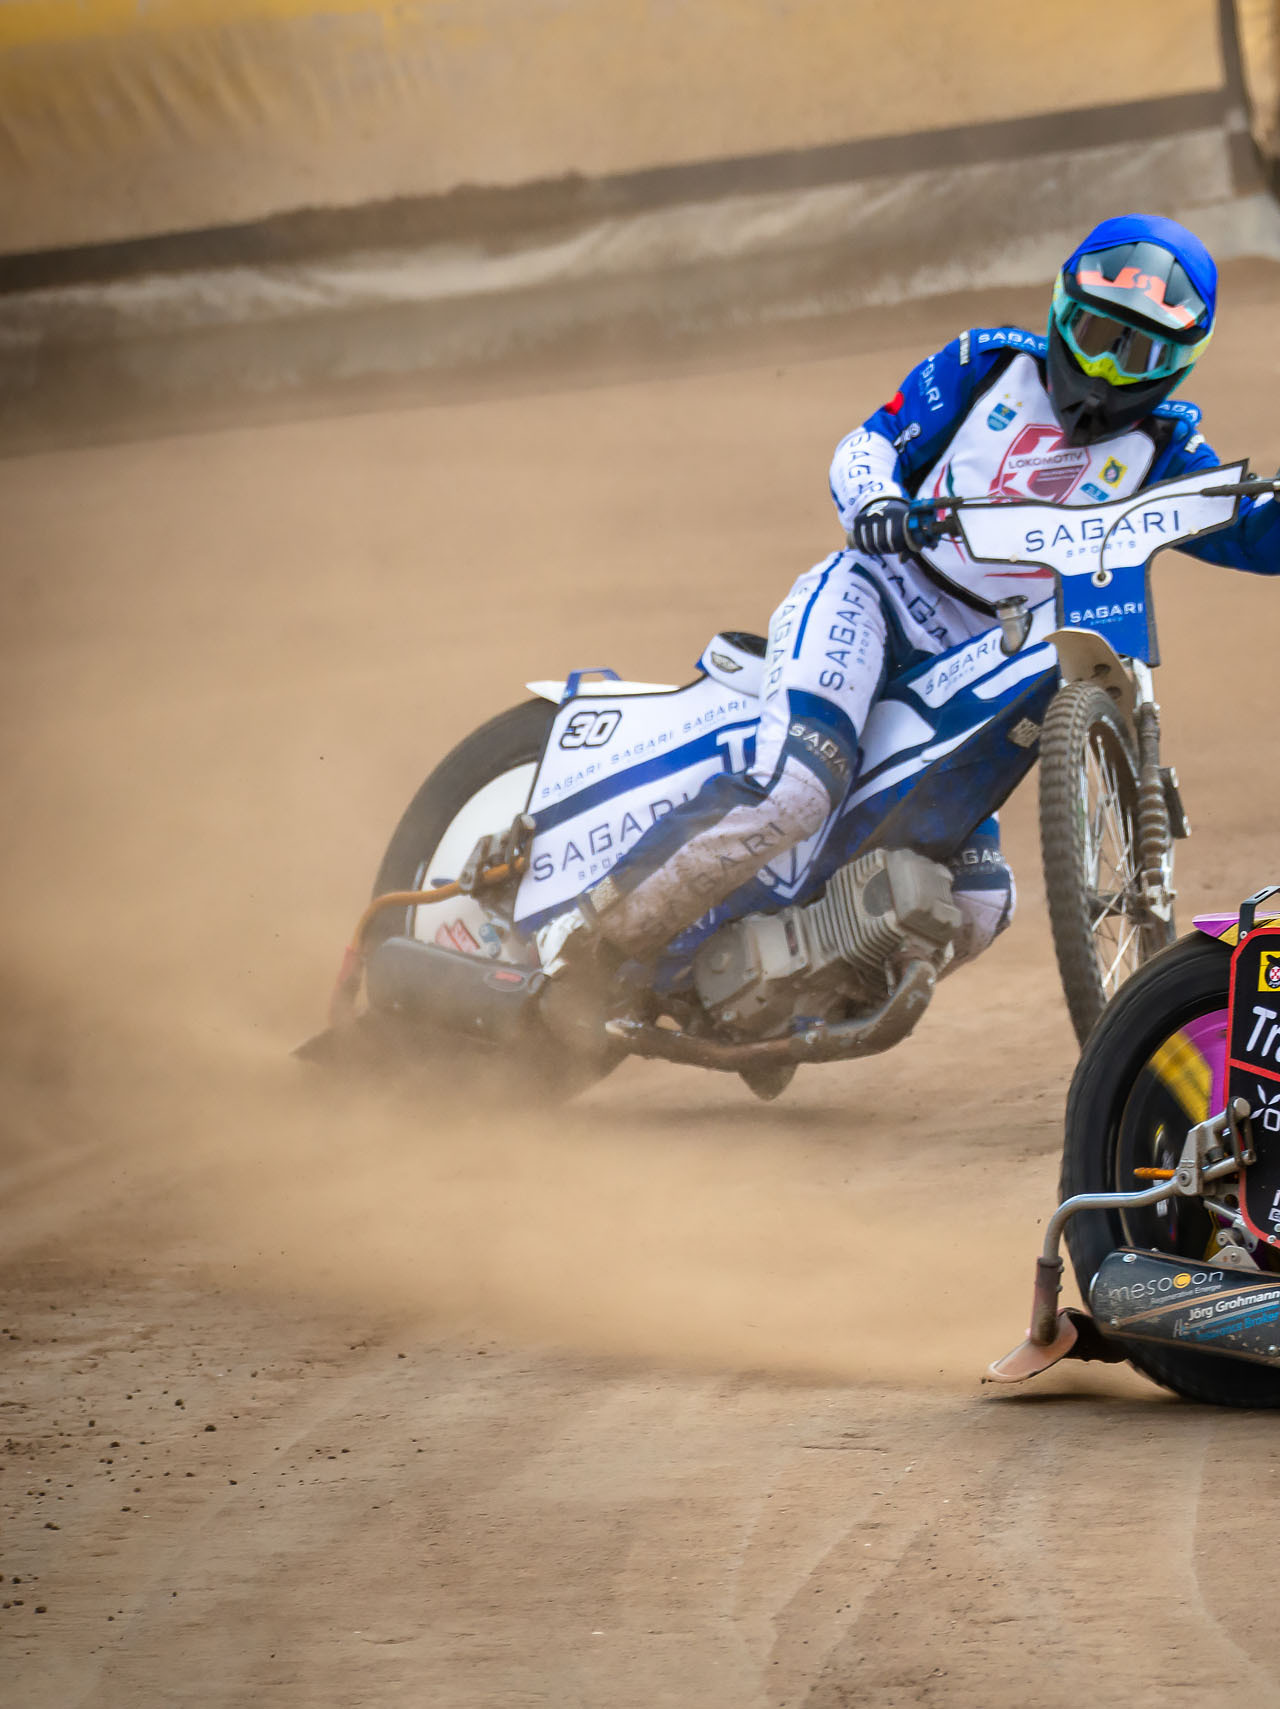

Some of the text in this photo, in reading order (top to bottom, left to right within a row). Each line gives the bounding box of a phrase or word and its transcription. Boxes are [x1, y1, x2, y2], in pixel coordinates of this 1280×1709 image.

[1007, 452, 1085, 470] LOKOMOTIV
[1025, 510, 1180, 553] SAGARI
[1066, 540, 1137, 559] SPORTS
[1069, 602, 1144, 624] SAGARI
[925, 639, 997, 695] SAGARI
[559, 709, 623, 751] 30
[541, 699, 748, 799] SAGARI SAGARI SAGARI
[532, 792, 690, 883] SAGAR
[1107, 1270, 1224, 1301] mesocon
[1188, 1290, 1280, 1322] Jörg Grohmann
